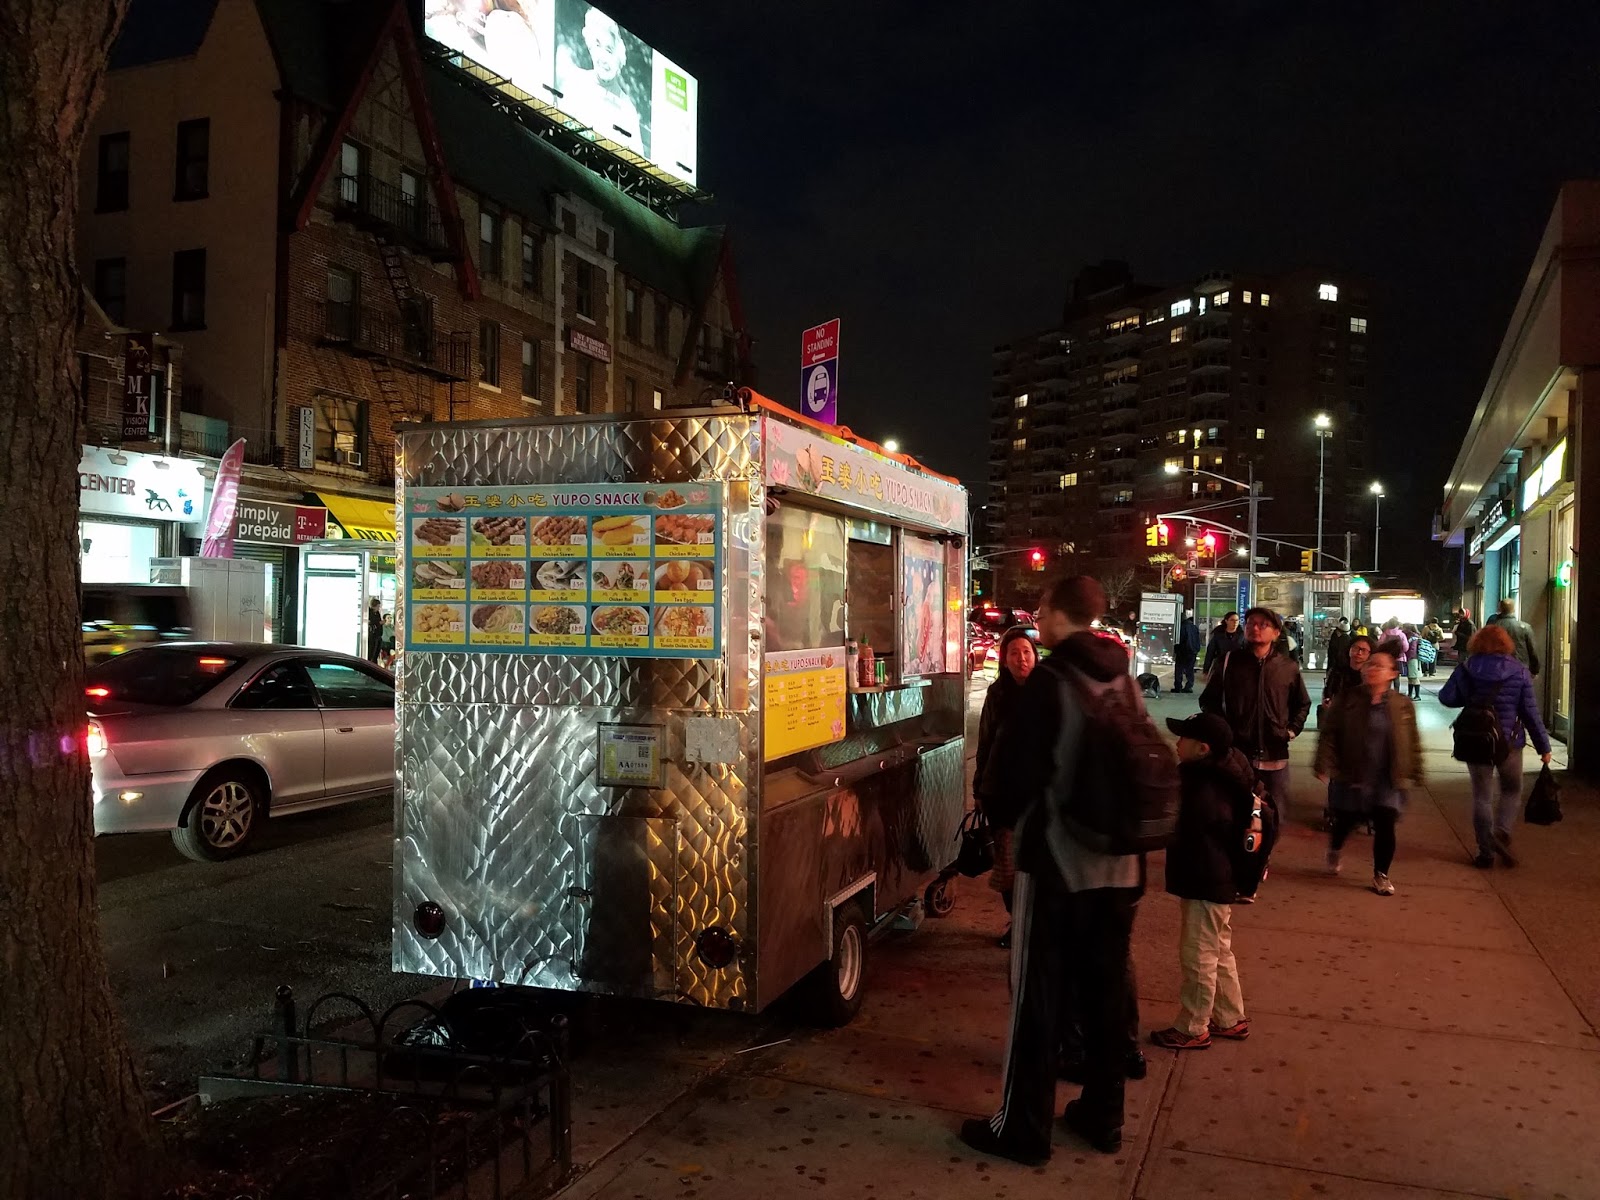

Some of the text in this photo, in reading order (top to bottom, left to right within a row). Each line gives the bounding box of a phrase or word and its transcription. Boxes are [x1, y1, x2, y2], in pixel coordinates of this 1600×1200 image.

[815, 328, 825, 339] NO
[807, 336, 834, 354] STANDING
[127, 375, 143, 394] M
[135, 396, 149, 415] K
[125, 417, 148, 426] VISION
[124, 427, 148, 436] CENTER
[301, 409, 312, 457] DENTIST
[79, 472, 136, 496] CENTER
[553, 492, 641, 506] YUPO SNACK
[886, 477, 933, 512] YUPO SNACK
[235, 503, 279, 525] simply
[238, 523, 291, 541] prepaid
